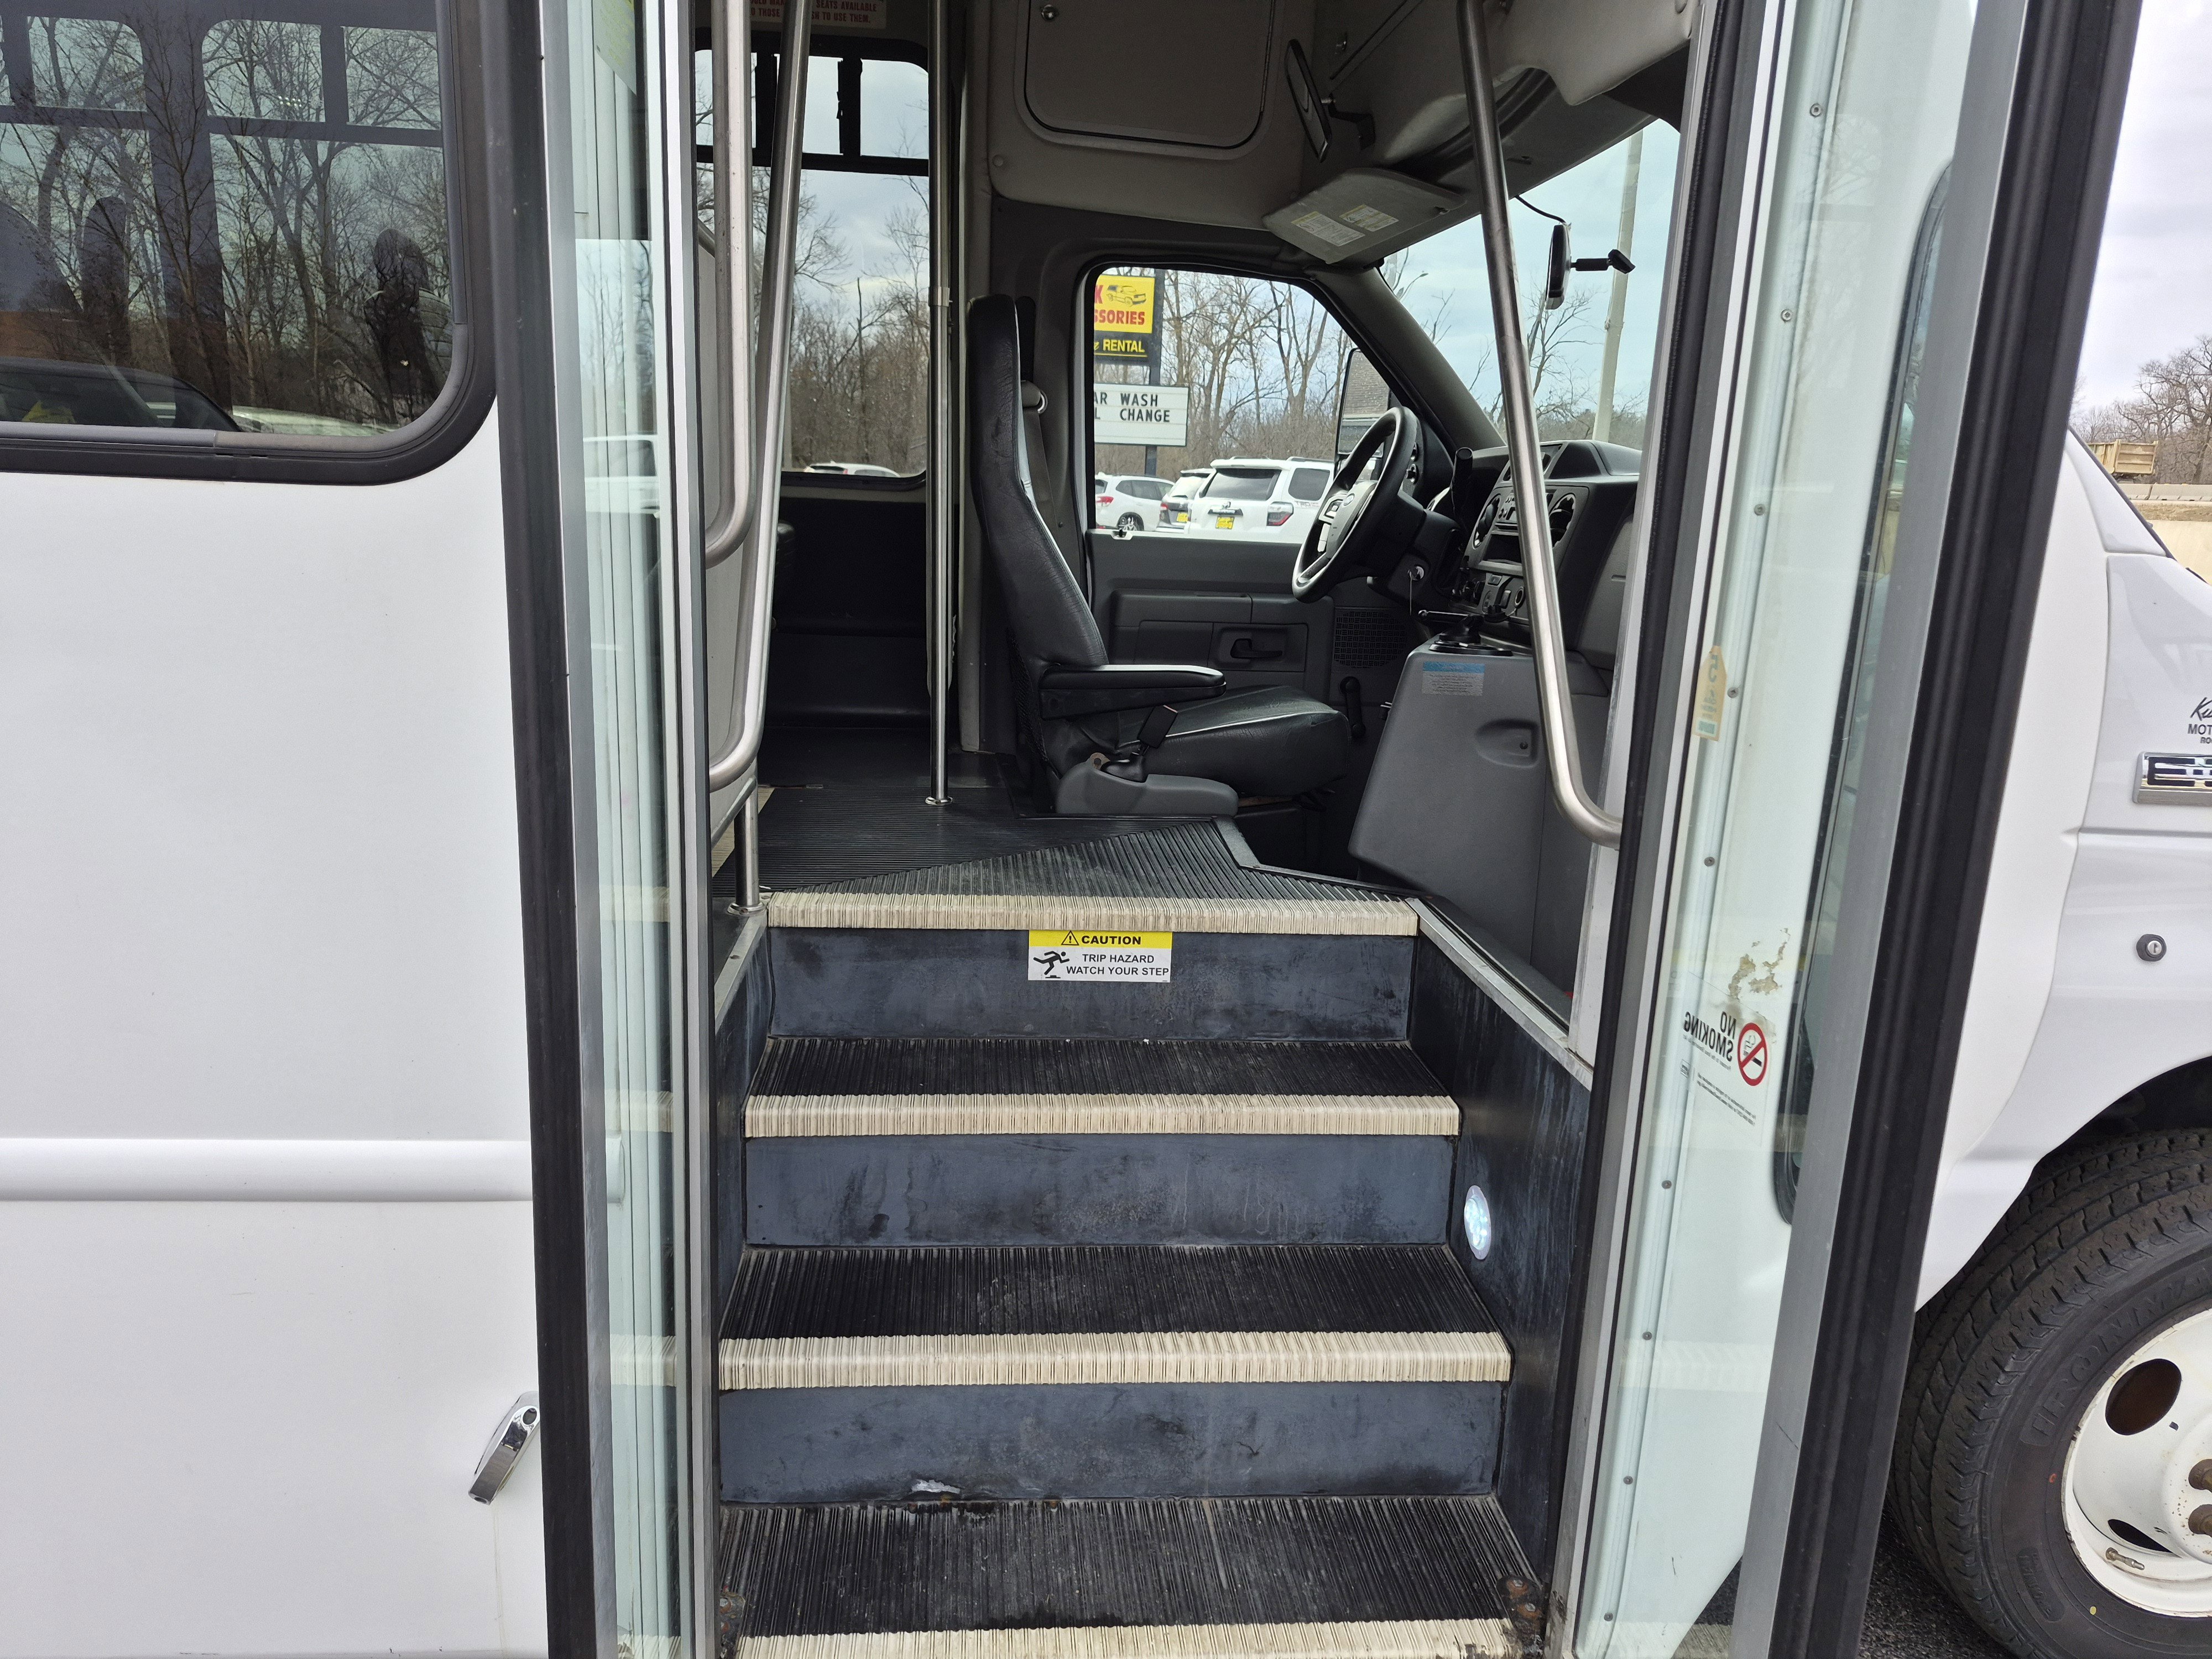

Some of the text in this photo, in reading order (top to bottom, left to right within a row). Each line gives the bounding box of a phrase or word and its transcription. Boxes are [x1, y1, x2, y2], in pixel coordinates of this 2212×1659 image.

[816, 0, 838, 9] SEATS
[841, 1, 877, 11] AVAILABLE
[759, 8, 780, 17] THOSE
[822, 12, 831, 20] TO
[834, 12, 847, 22] USE
[1103, 338, 1145, 353] RENTAL
[1094, 392, 1158, 406] AR WASH
[1094, 407, 1170, 422] L CHANGE
[1081, 935, 1141, 945] CAUTION
[1082, 953, 1155, 963] TRIP HAZARD
[1066, 966, 1169, 976] WATCH YOUR STEP
